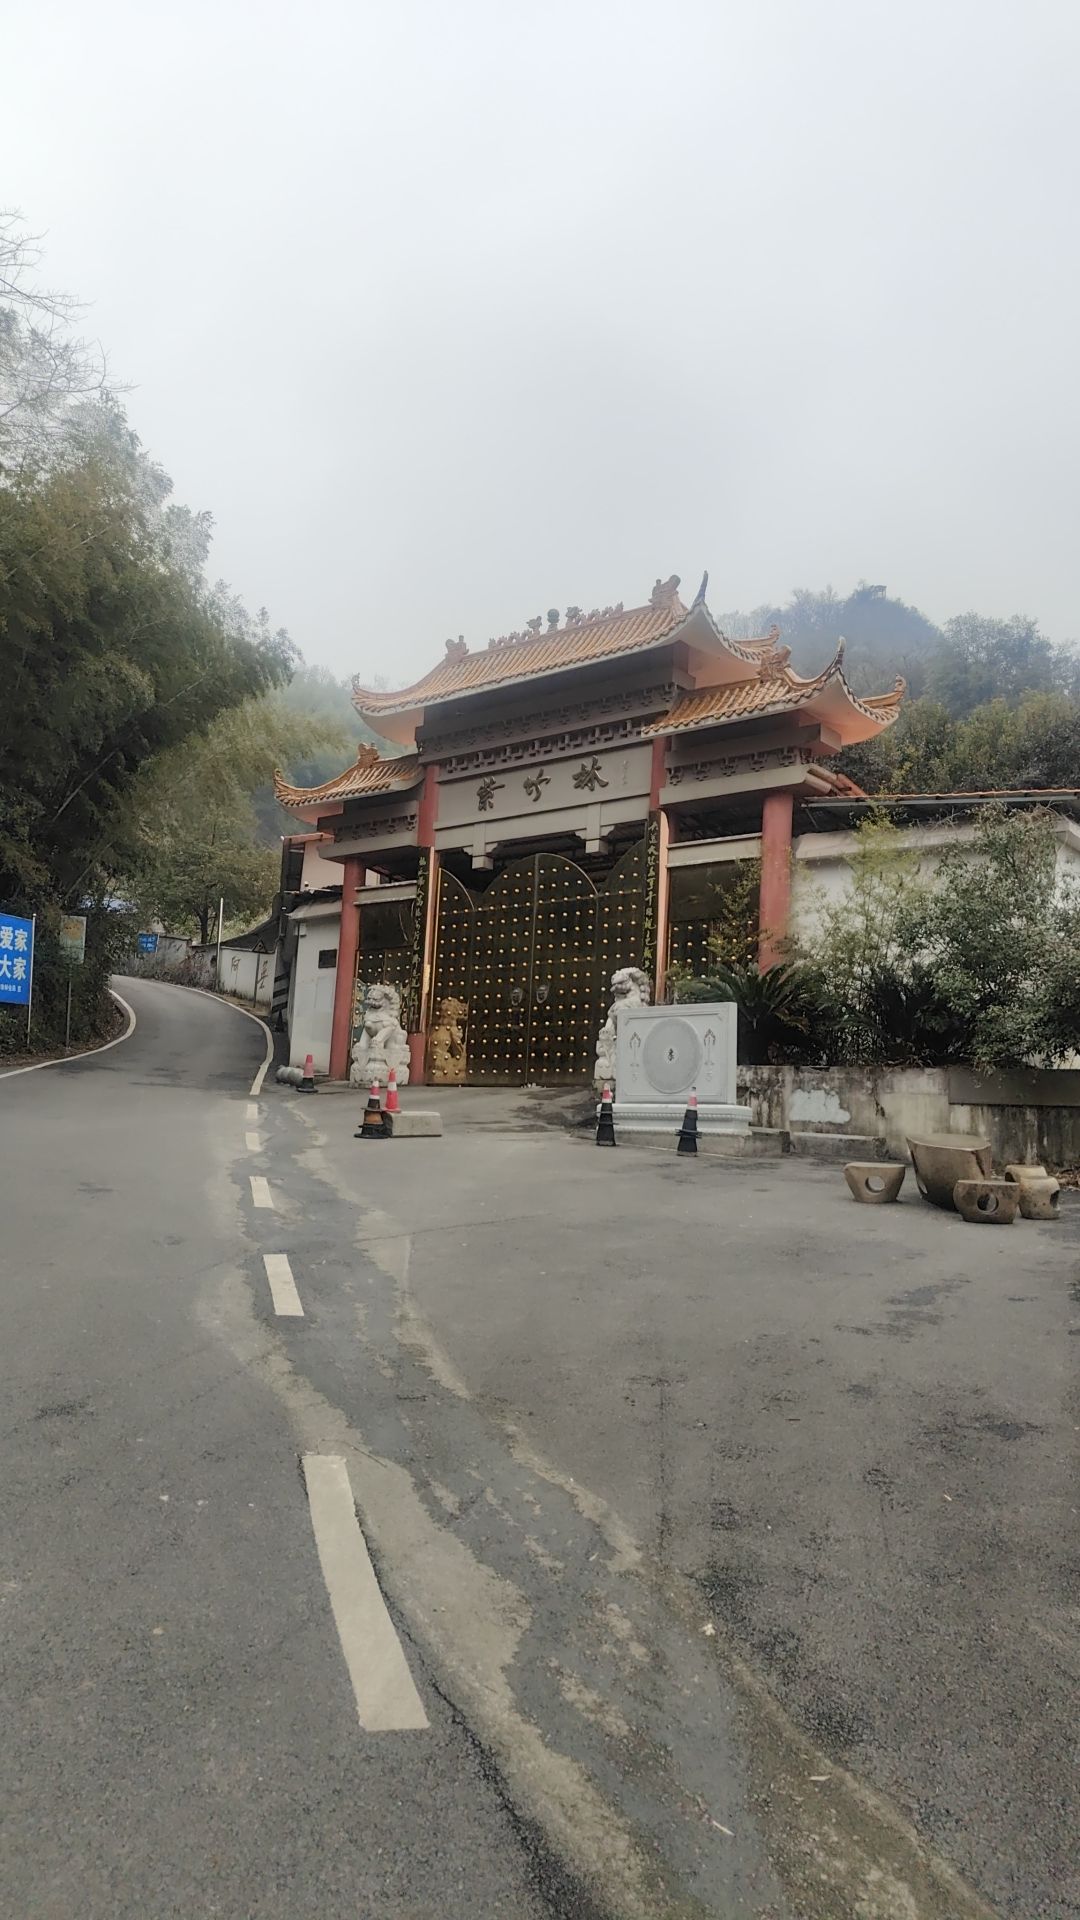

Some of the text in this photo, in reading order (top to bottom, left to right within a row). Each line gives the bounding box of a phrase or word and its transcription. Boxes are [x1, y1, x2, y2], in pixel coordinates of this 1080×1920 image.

[476, 754, 609, 812] 紫竹林
[0, 926, 28, 952] 爱家
[0, 953, 27, 981] 大家
